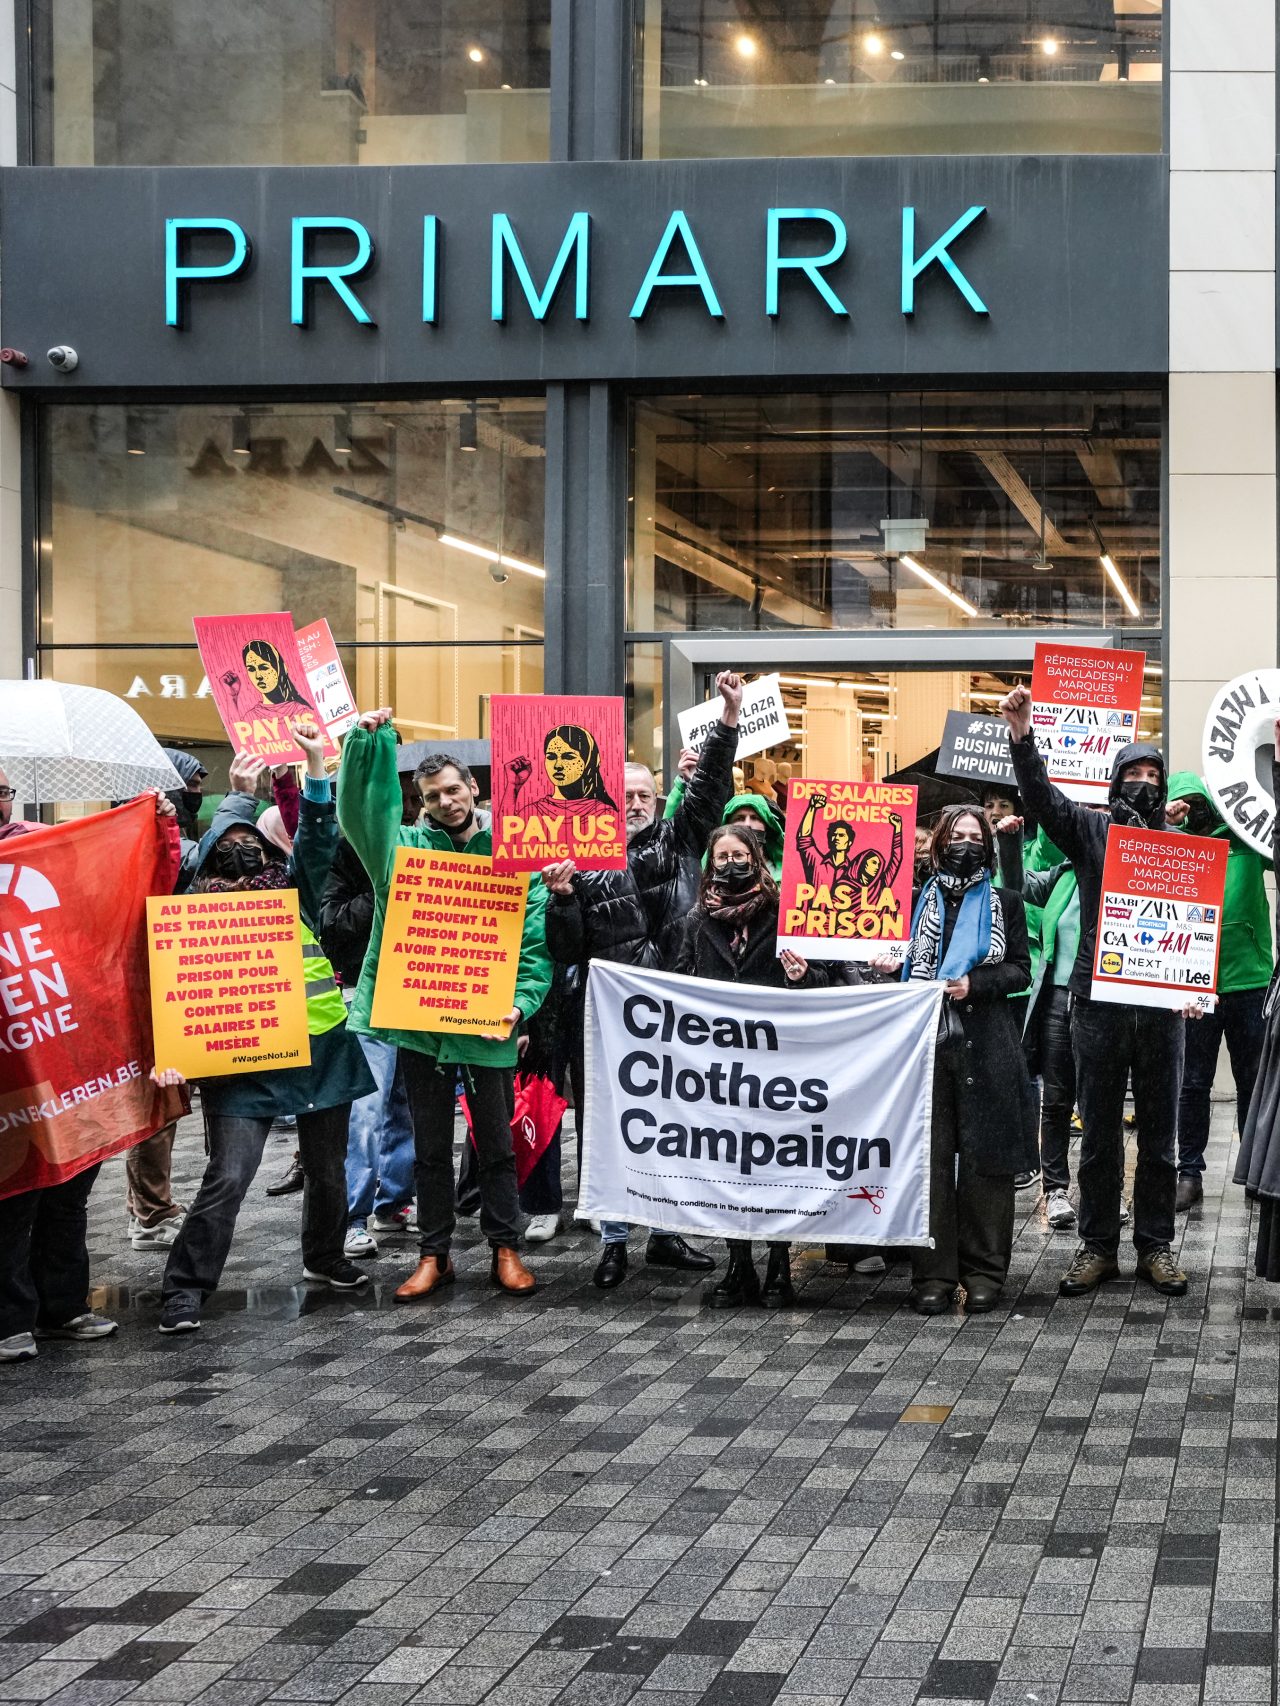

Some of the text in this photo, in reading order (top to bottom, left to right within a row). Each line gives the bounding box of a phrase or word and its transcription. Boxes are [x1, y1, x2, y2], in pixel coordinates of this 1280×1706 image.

[165, 205, 989, 328] PRIMARK
[1045, 654, 1133, 672] RÉPRESSION AU
[1047, 667, 1123, 682] BANGLADESH
[1059, 680, 1114, 692] MARQUES
[1053, 690, 1117, 704] COMPLICES
[234, 716, 279, 745] PAY
[740, 711, 779, 738] AGAIN
[968, 721, 1010, 739] #STO
[249, 740, 292, 756] LIVING
[954, 736, 1012, 758] BUSINE
[952, 755, 1013, 777] IMPUNIT
[793, 782, 913, 805] DES SALAIRES
[823, 804, 892, 823] DIGNES
[502, 815, 616, 842] PAY US
[496, 843, 623, 859] A LIVING WAGE
[1119, 839, 1215, 861] RÉPRESSION AU
[406, 858, 425, 868] AU
[1122, 853, 1204, 873] BANGLADESH
[396, 874, 523, 896] DES TRAVAILLEURS
[1134, 868, 1194, 884] MARQUES
[796, 883, 897, 912] PAS LA
[1128, 880, 1198, 897] COMPLICES
[161, 899, 286, 915] AU BANGLADESH,
[395, 891, 519, 912] ET TRAVAILLEUSES
[1106, 896, 1138, 907] KIABI
[1140, 899, 1178, 920] ZARA
[153, 915, 294, 933] DES TRAVAILLEURS
[412, 910, 497, 927] RISQUENT LA
[785, 909, 903, 938] PRISON
[156, 931, 294, 950] ET TRAVAILLEUSES
[407, 927, 498, 944] PRISON POUR
[1103, 931, 1128, 947] C&A
[1157, 932, 1192, 955] H&M
[179, 950, 274, 966] RISQUENT LA
[394, 943, 507, 962] AVOIR PROTESTÉ
[407, 961, 490, 977] CONTRE DES
[1128, 957, 1162, 968] NEXT
[177, 966, 278, 983] PRISON POUR
[1186, 969, 1210, 985] Lee
[165, 979, 291, 1002] AVOIR PROTESTÉ
[403, 978, 489, 994] SALAIRES DE
[184, 1000, 276, 1018] CONTRE DES
[419, 995, 468, 1010] MISÈRE
[184, 1017, 279, 1036] SALAIRES DE
[440, 1016, 500, 1027] #WagesNotJail
[623, 994, 778, 1051] Clean
[206, 1036, 259, 1051] MISÈRE
[232, 1050, 299, 1063] #WagesNotJail
[618, 1050, 829, 1114] Clothes
[620, 1108, 891, 1181] Campaign
[652, 1197, 678, 1206] working
[680, 1200, 718, 1209] conditions
[728, 1204, 739, 1212] the
[741, 1205, 763, 1214] global
[798, 1208, 827, 1217] industry
